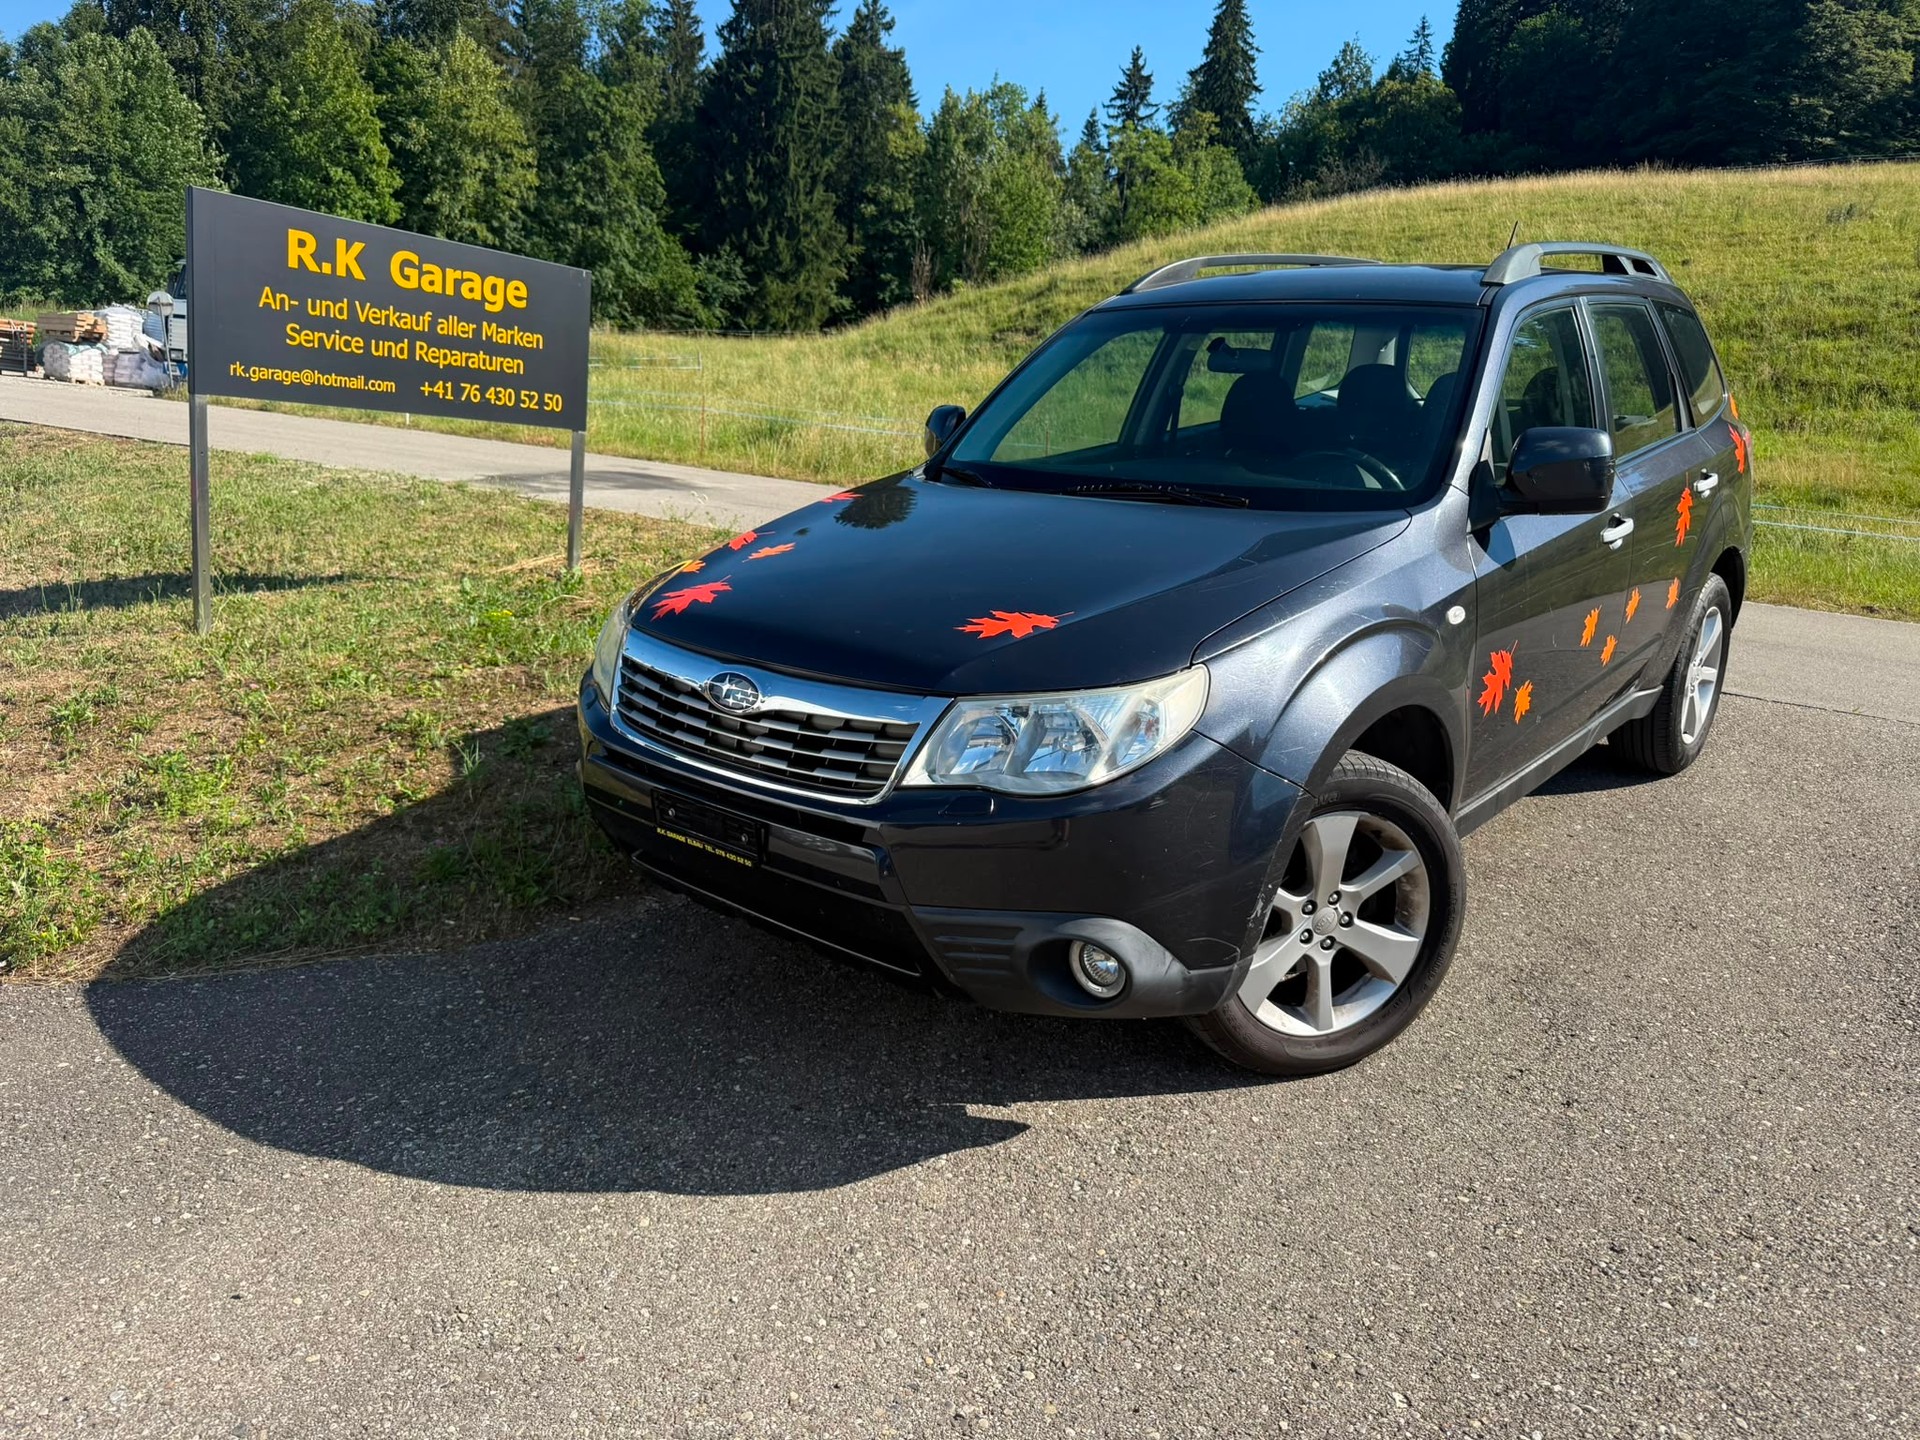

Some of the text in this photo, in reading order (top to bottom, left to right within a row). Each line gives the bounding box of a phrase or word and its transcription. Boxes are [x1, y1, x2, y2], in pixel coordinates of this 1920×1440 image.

[288, 229, 528, 312] R.K Garage
[259, 286, 544, 349] An- und Verkauf aller Marken
[286, 322, 524, 375] Service und Reparaturen
[229, 362, 396, 393] rk.garage@hotmail.com
[420, 380, 563, 412] +41 76 430 52 50
[667, 830, 686, 843] GARAGE
